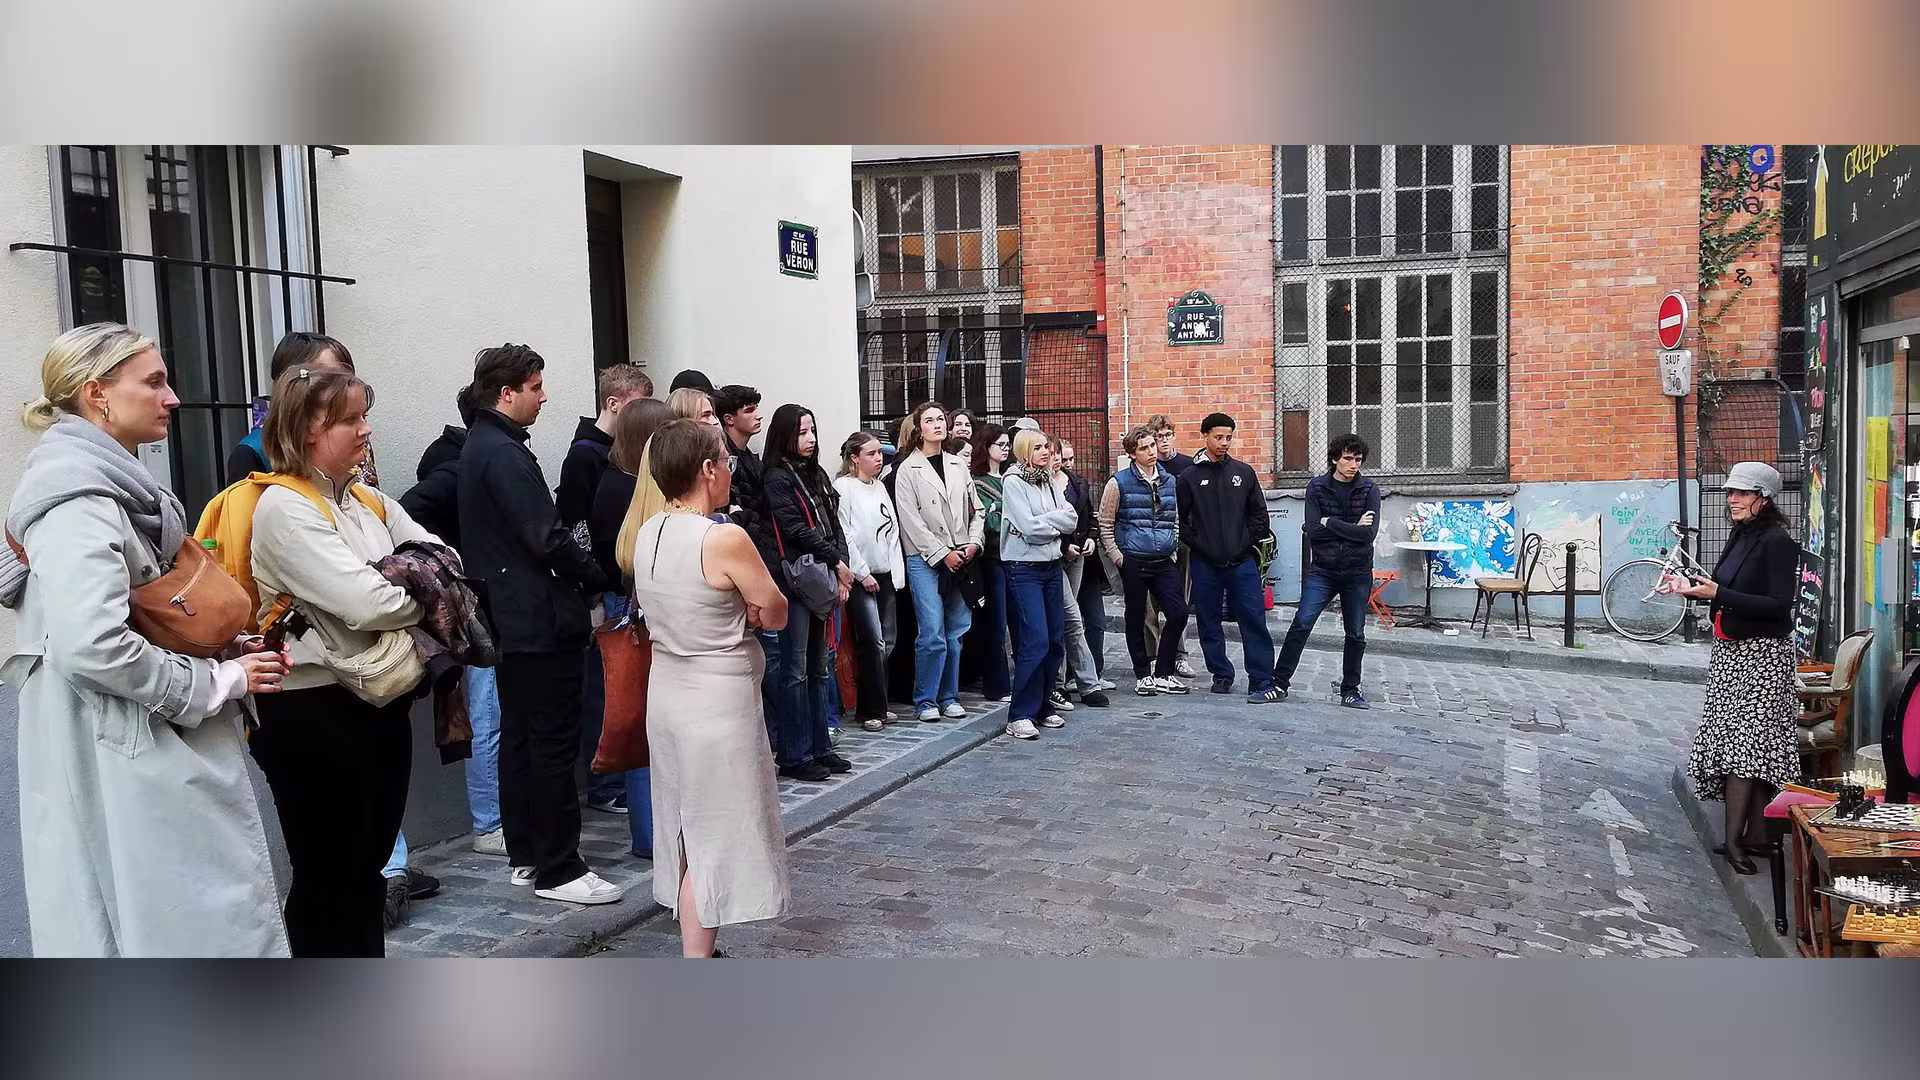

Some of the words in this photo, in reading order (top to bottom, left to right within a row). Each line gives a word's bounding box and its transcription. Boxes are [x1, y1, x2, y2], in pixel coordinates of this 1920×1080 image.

[790, 240, 809, 256] RUE
[785, 252, 814, 272] VÉRON
[1187, 313, 1205, 321] RUE
[1177, 330, 1215, 339] ANTOINE
[1664, 354, 1681, 365] SAUF
[1635, 528, 1658, 537] AVEC
[1629, 537, 1643, 545] UN
